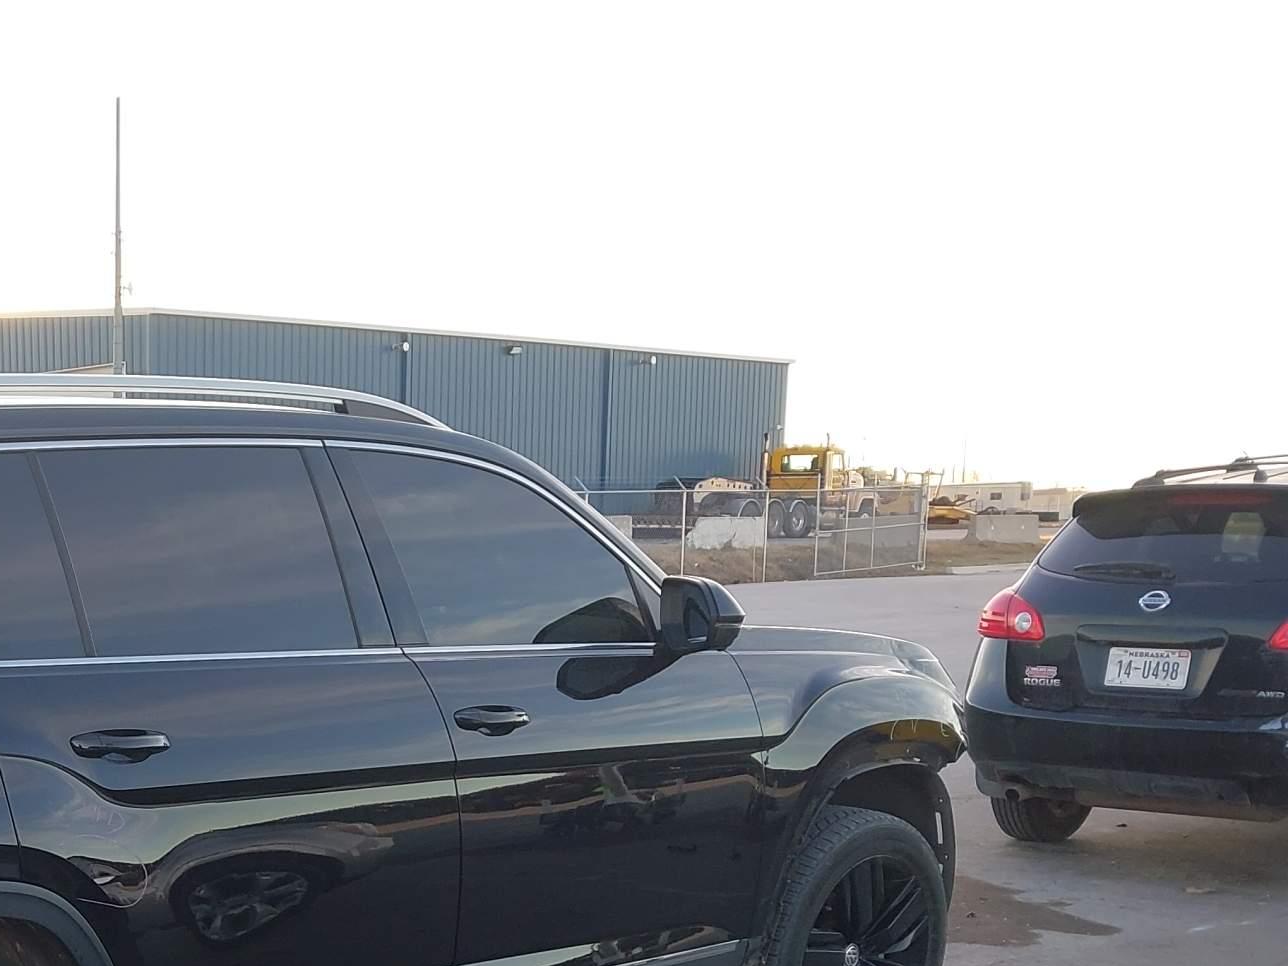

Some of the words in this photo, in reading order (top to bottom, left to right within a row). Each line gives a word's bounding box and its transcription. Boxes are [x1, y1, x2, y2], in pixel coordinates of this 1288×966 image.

[1128, 651, 1171, 659] NEBRASKA
[1117, 659, 1180, 681] 14-U498
[1023, 677, 1062, 688] ROGUE
[1256, 690, 1286, 699] AWD
